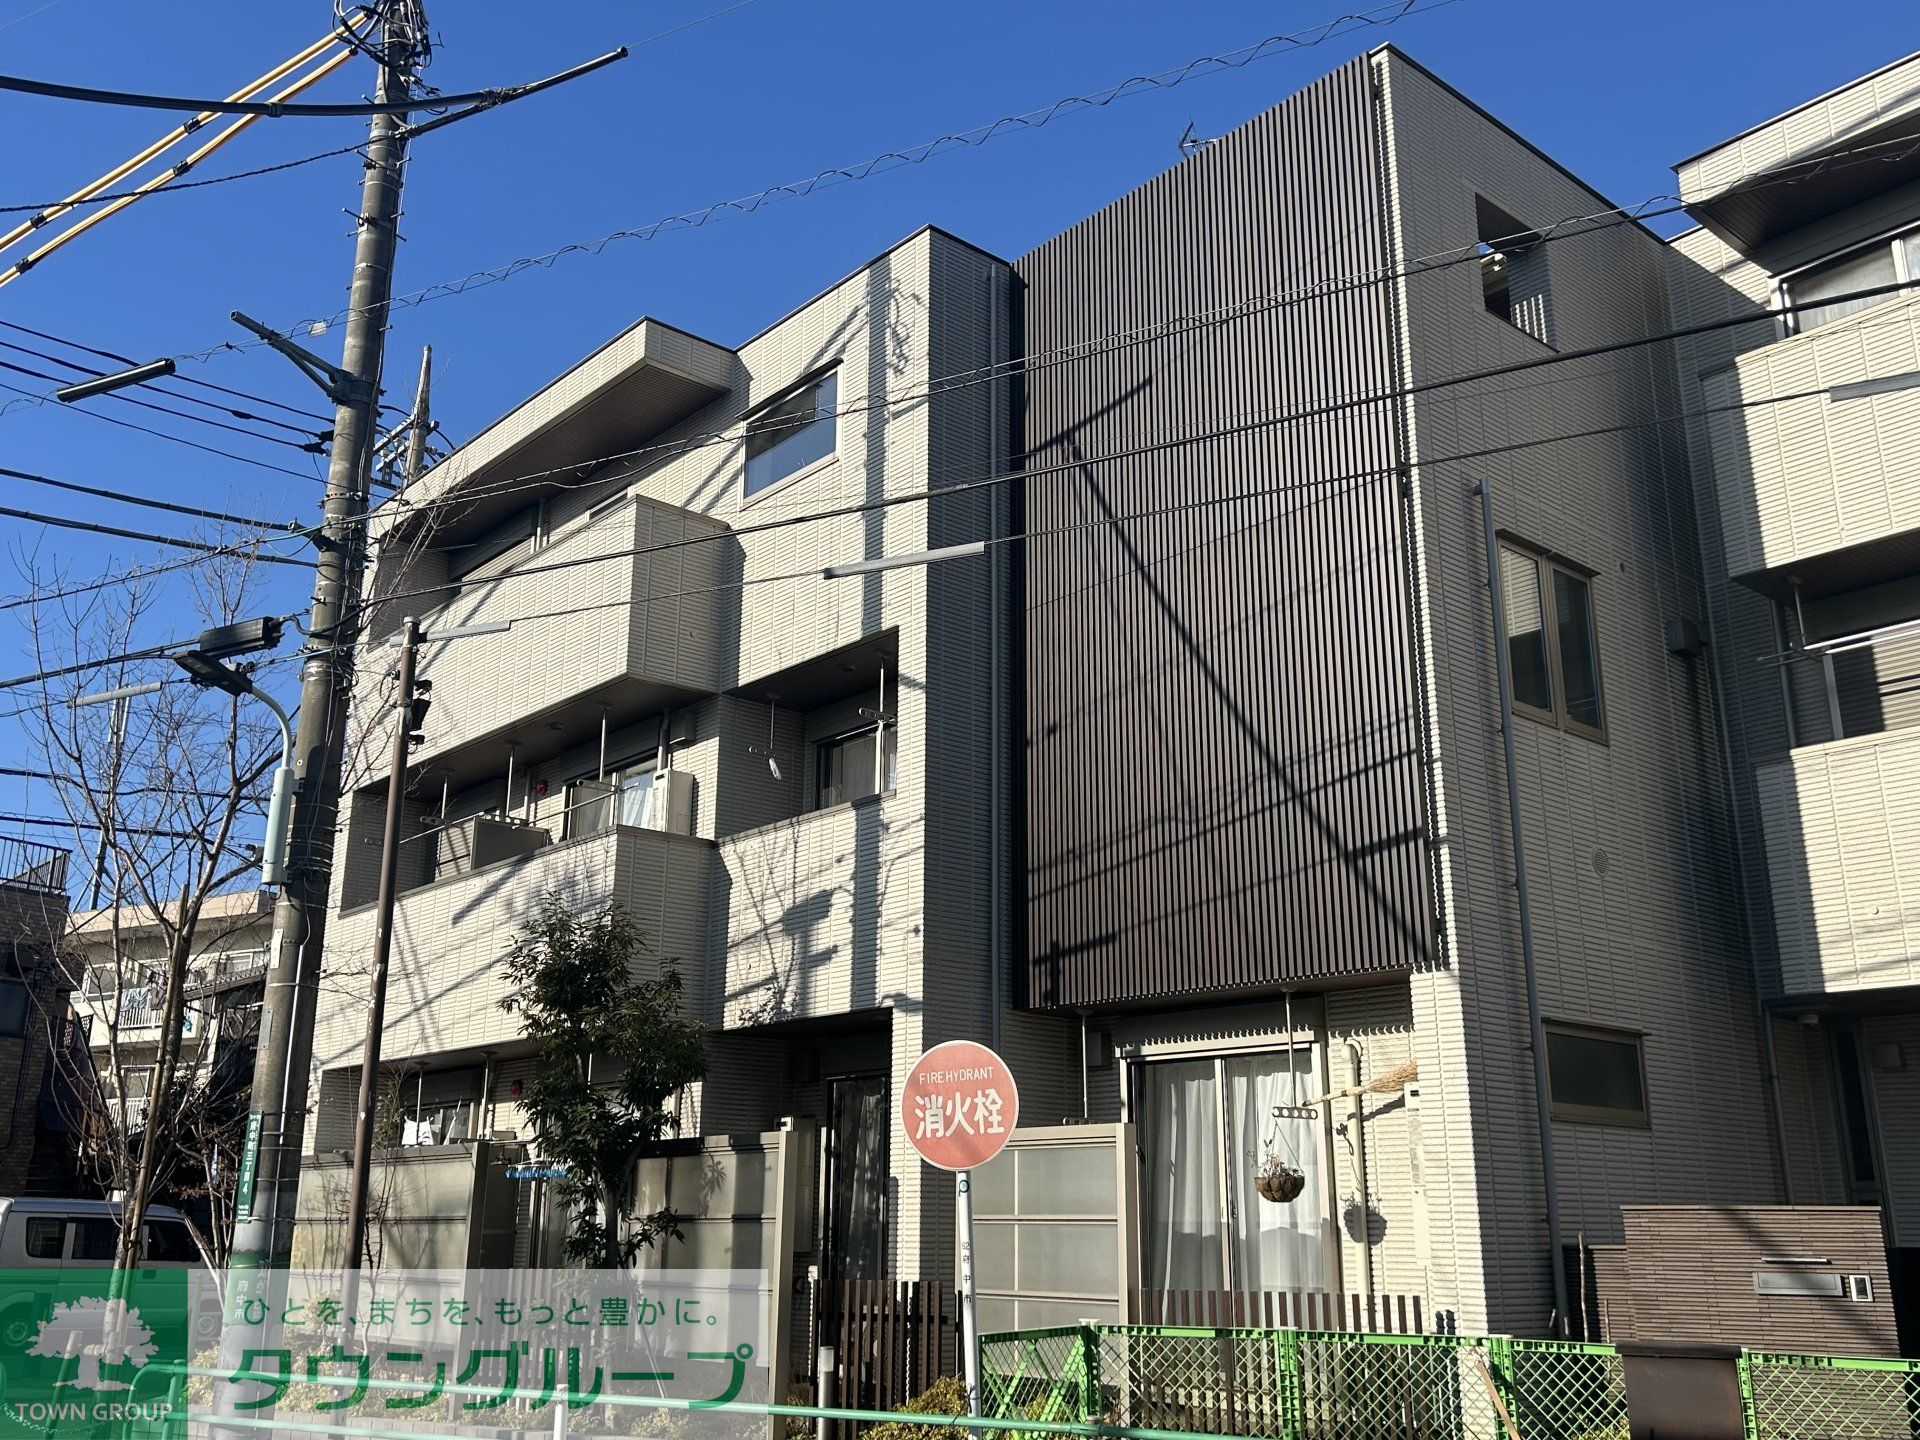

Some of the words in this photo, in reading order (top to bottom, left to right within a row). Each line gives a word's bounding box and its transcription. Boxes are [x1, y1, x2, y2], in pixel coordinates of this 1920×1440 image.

[919, 1071, 945, 1085] FIRE
[945, 1066, 994, 1082] HYDRANT
[914, 1088, 1005, 1140] 消火栓
